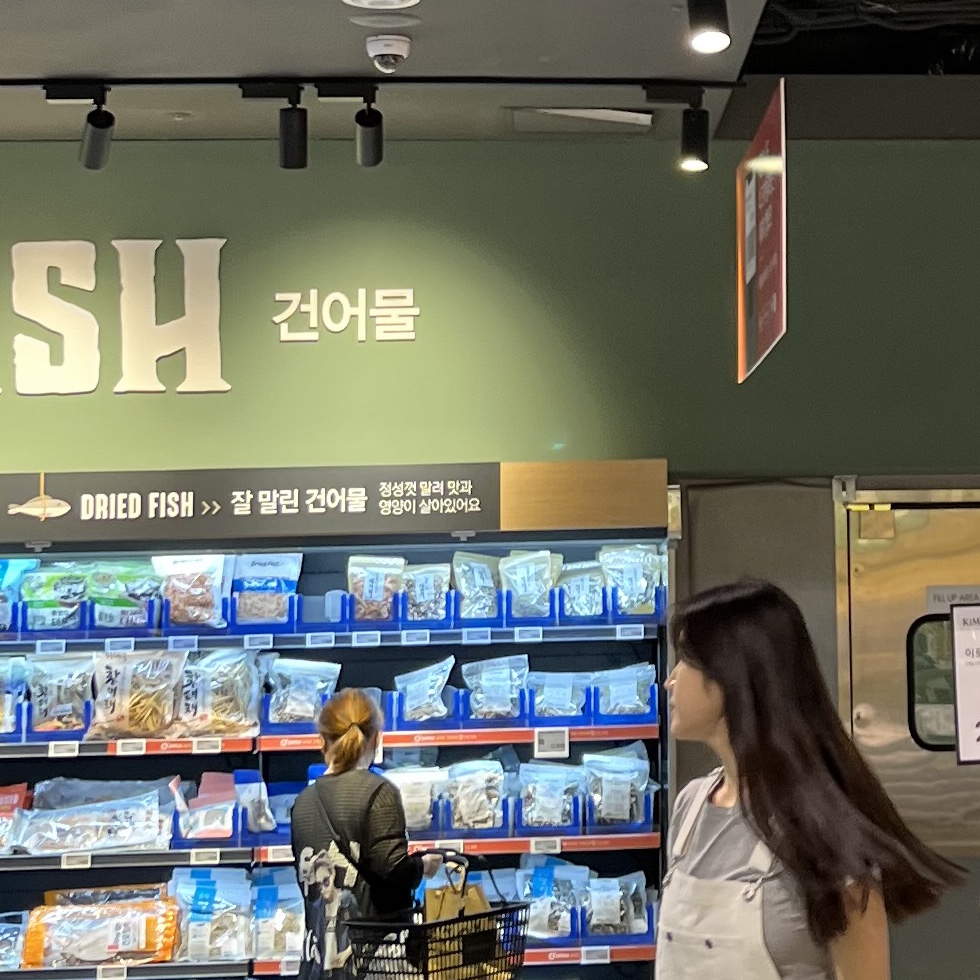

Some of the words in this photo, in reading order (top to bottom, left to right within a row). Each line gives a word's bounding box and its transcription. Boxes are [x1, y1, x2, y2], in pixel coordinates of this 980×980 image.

[0, 238, 232, 395] SH
[271, 288, 420, 342] 건어물
[231, 490, 251, 516] 잘
[258, 489, 299, 514] 말린
[305, 487, 368, 513] 건어물
[379, 481, 417, 497] 정성껏
[447, 480, 473, 496] 맛과
[80, 492, 141, 520] DRIED
[148, 491, 194, 518] FISH
[379, 498, 417, 515] 영양이
[418, 497, 482, 514] 살아있어요
